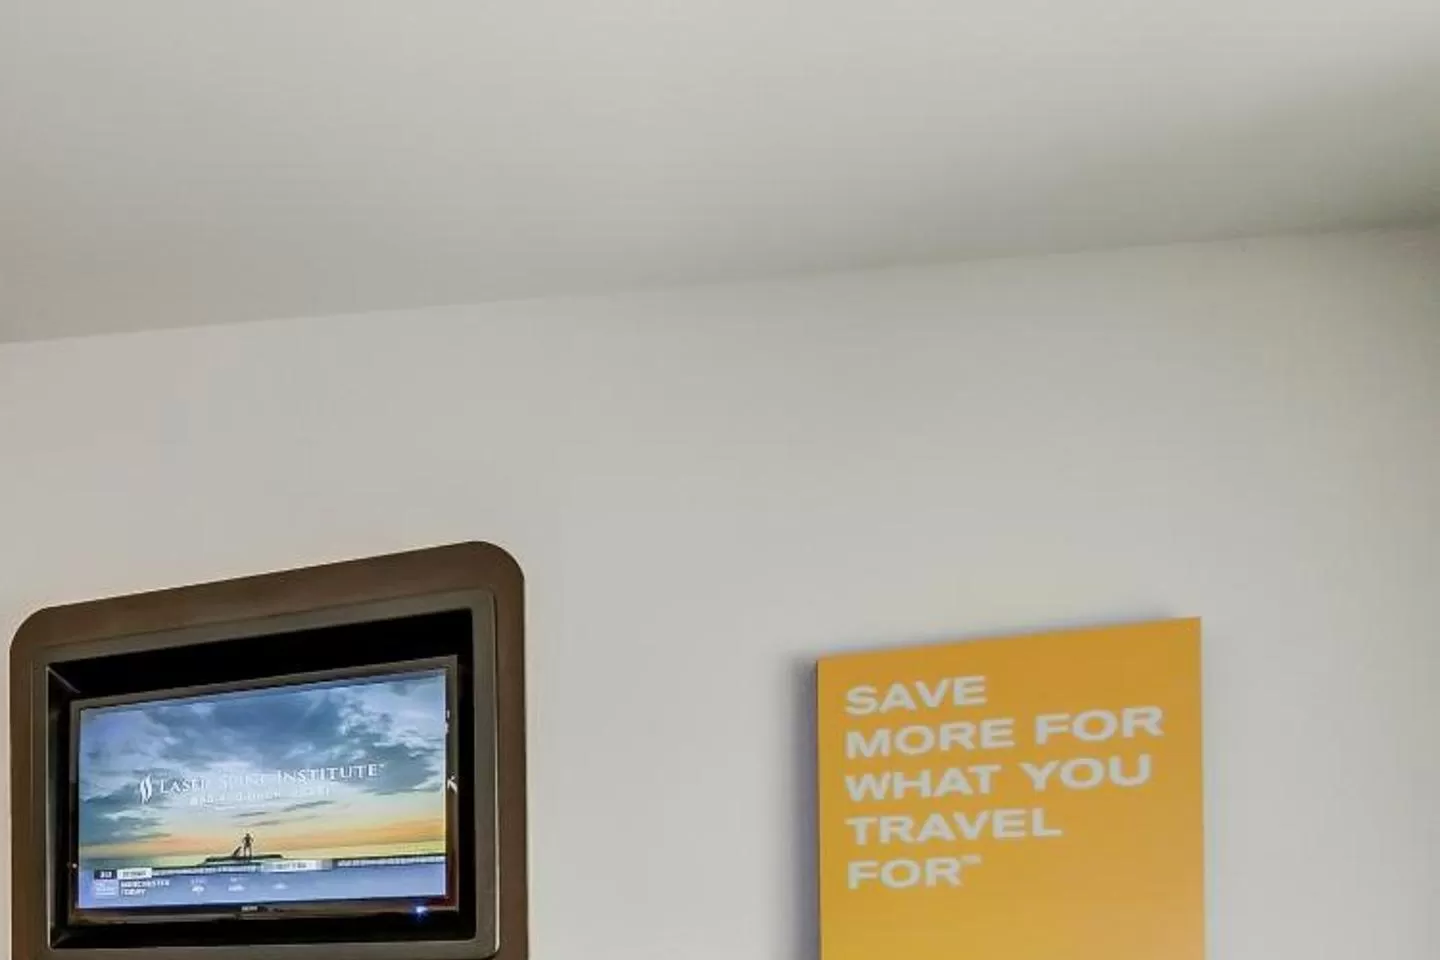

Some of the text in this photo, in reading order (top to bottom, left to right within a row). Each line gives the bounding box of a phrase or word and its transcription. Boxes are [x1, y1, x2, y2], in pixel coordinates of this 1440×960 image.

[844, 675, 987, 716] SAVE
[844, 706, 1164, 760] MORE FOR
[844, 753, 1152, 802] WHAT YOU
[844, 808, 1064, 846] TRAVEL
